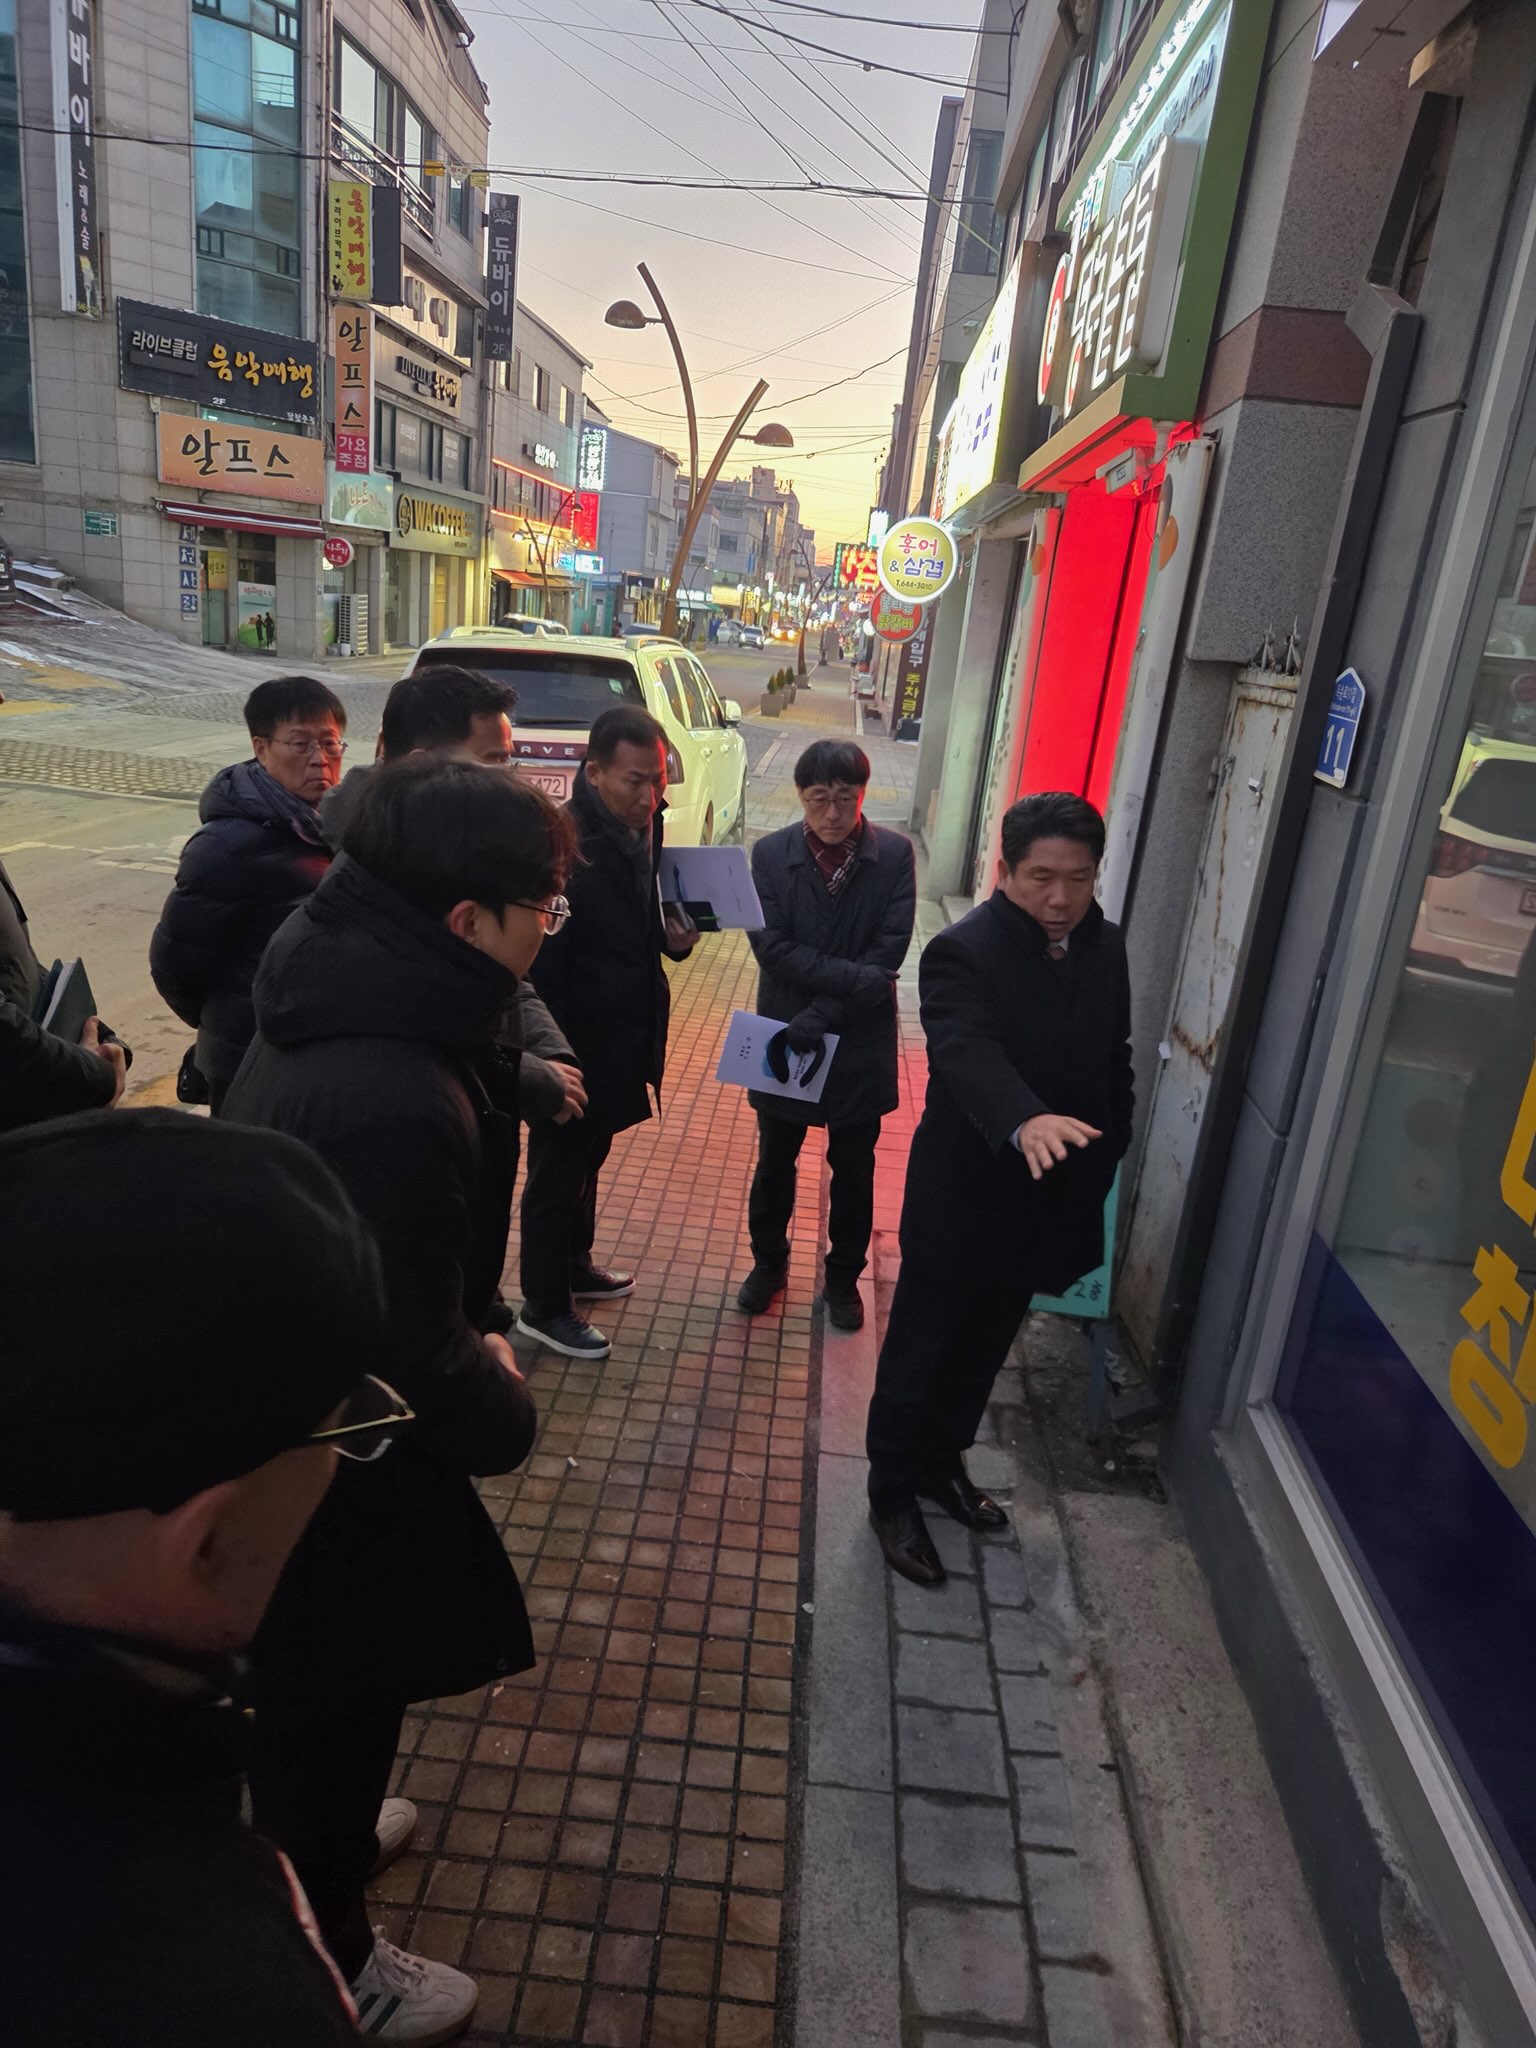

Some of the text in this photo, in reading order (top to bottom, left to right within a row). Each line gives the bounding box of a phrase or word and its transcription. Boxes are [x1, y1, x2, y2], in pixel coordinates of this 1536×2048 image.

[132, 330, 198, 361] 라이브클럽
[208, 343, 314, 398] 음악여행
[338, 316, 368, 429] 알프스
[212, 397, 226, 406] 2F
[181, 428, 294, 479] 알프스
[338, 436, 368, 453] 가요
[338, 452, 367, 469] 주점
[898, 533, 938, 557] 홍어
[889, 560, 900, 573] &
[904, 557, 944, 580] 삼겹
[1323, 724, 1345, 768] 11
